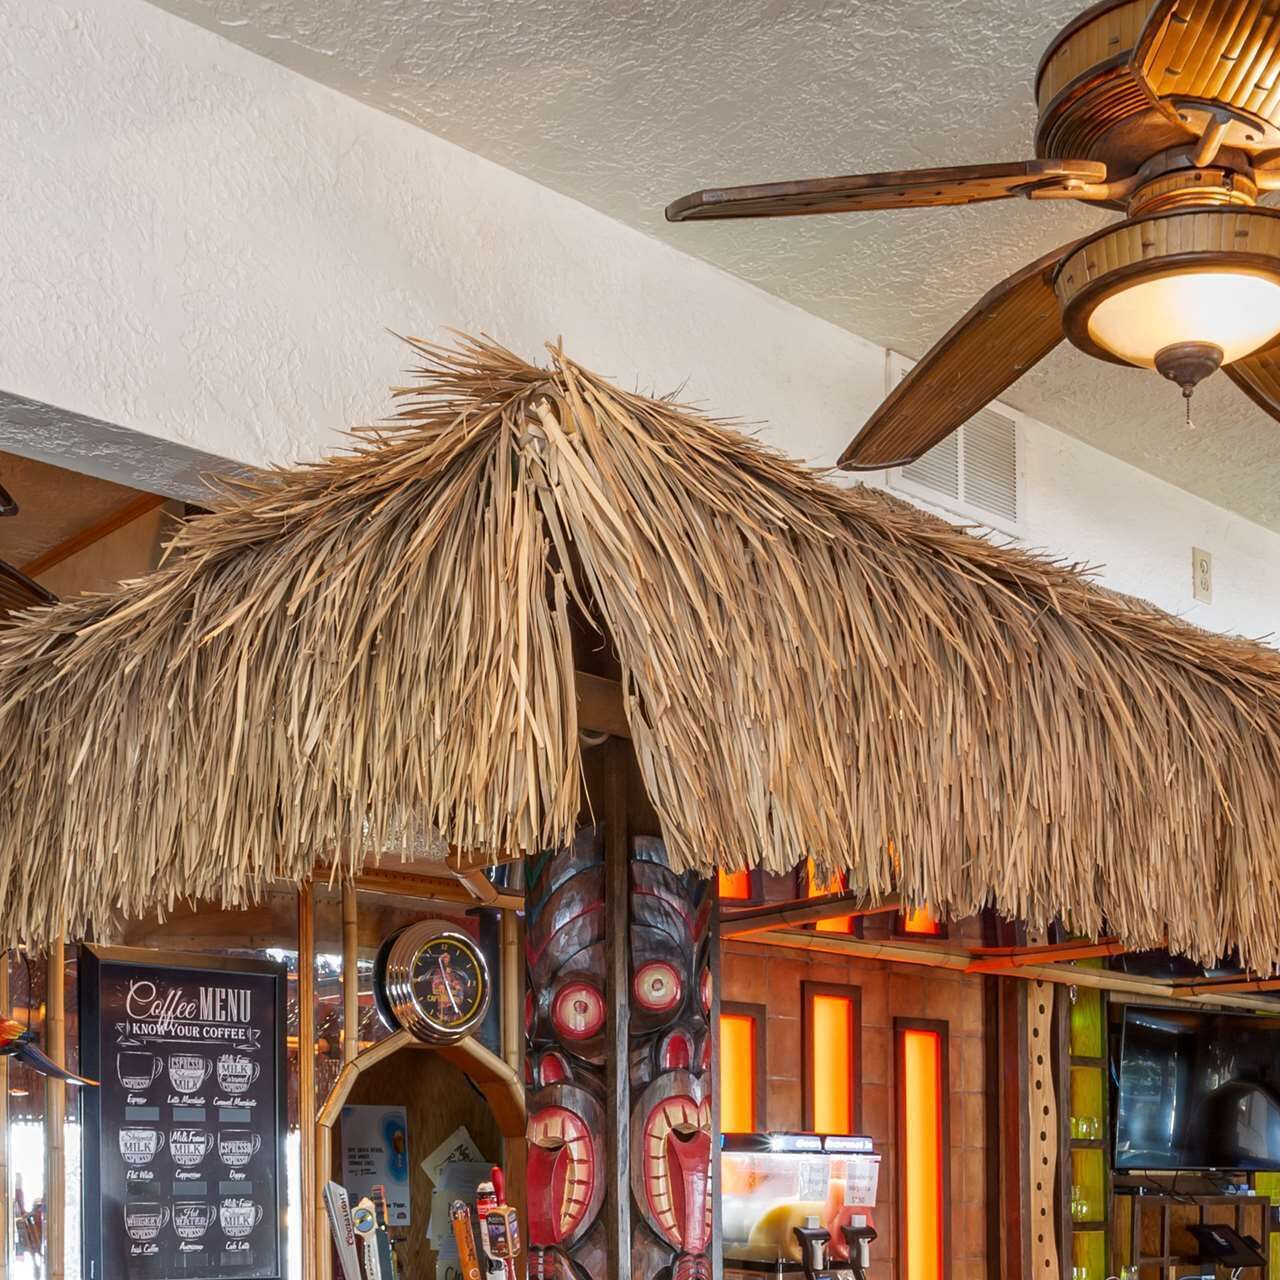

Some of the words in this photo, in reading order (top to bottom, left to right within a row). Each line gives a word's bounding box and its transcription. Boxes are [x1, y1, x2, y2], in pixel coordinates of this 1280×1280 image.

[126, 979, 197, 1031] Coffee
[199, 987, 251, 1022] MENU
[132, 1023, 166, 1036] KNOW
[169, 1025, 200, 1037] YOUR
[202, 1027, 246, 1039] COFFEE
[221, 1064, 248, 1074] MILK
[123, 1142, 152, 1152] MILK
[174, 1144, 203, 1155] MILK
